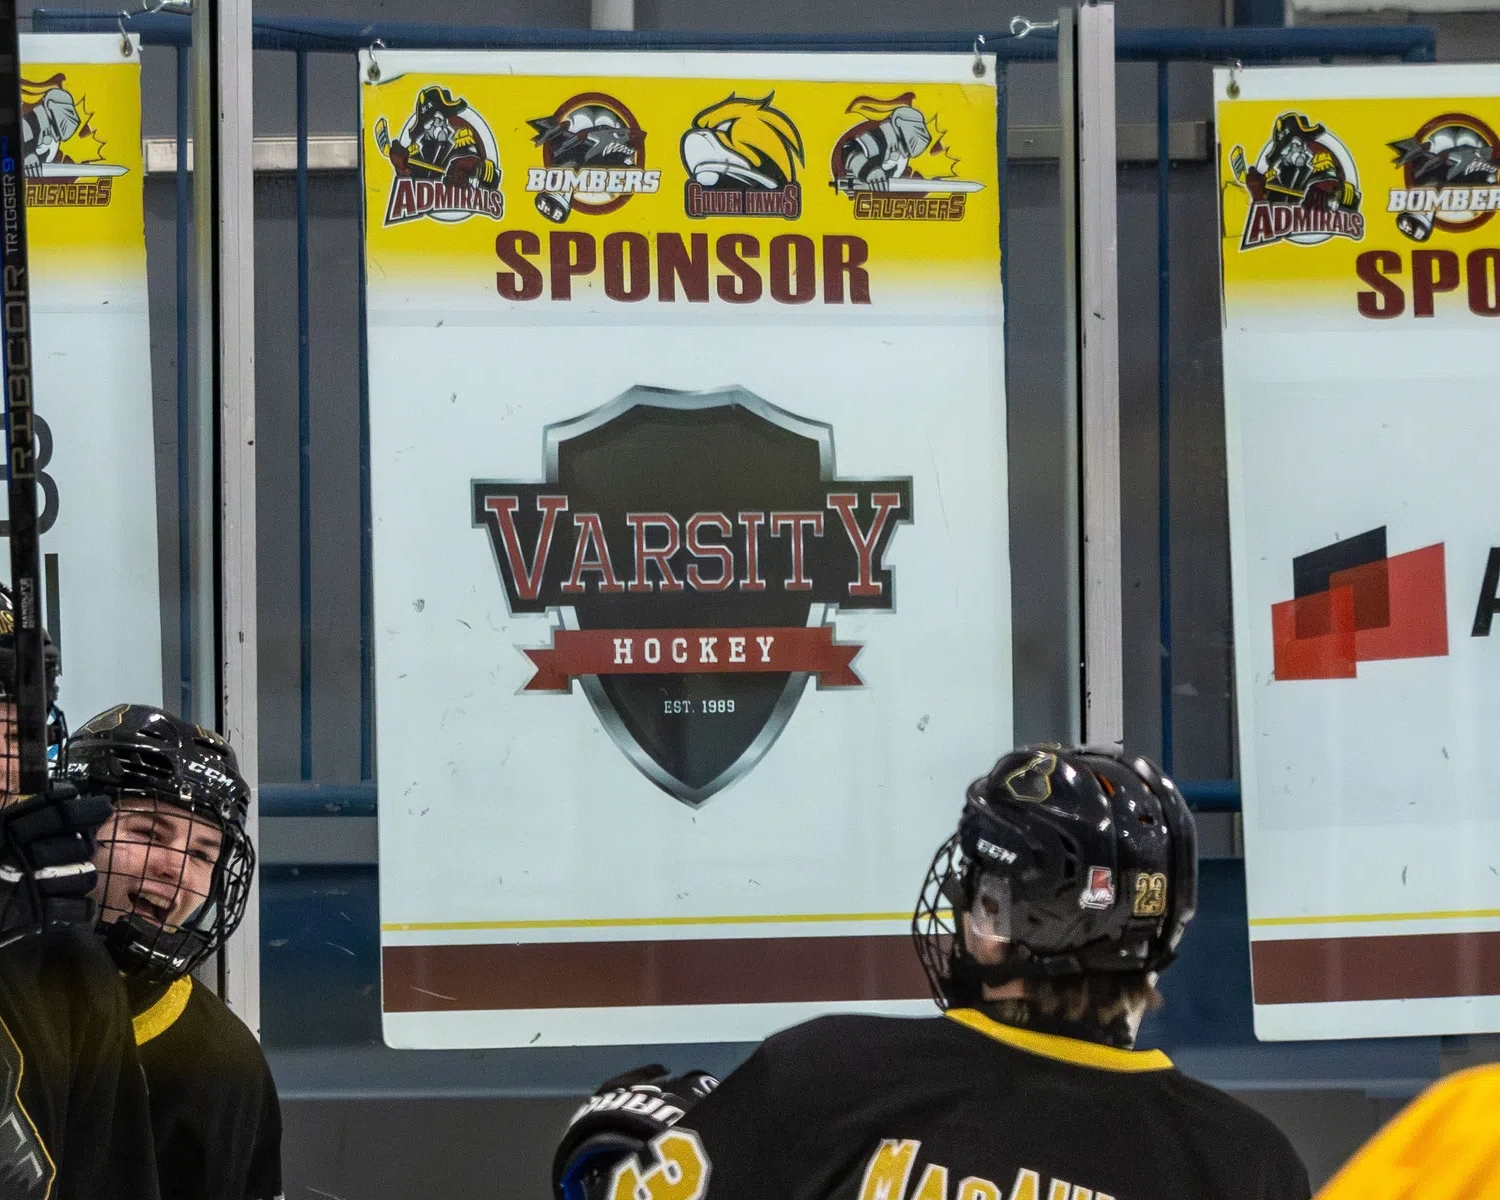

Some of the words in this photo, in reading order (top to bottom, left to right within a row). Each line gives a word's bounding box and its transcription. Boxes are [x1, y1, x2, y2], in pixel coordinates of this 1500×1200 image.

[26, 178, 112, 207] RUSADERS
[526, 168, 661, 194] BOMBERS
[391, 178, 503, 219] ADMIRALS
[855, 193, 966, 221] CRUSADERS
[2, 175, 19, 256] TRIGGER
[1248, 203, 1364, 241] ADMIRALS
[495, 230, 872, 305] SPONSOR
[4, 265, 36, 480] RIBCOR
[485, 493, 900, 600] VARSITY
[613, 635, 776, 665] HOCKEY
[664, 700, 695, 715] EST.
[702, 699, 735, 714] 1989
[187, 761, 237, 788] CCM
[976, 836, 1019, 865] CCM
